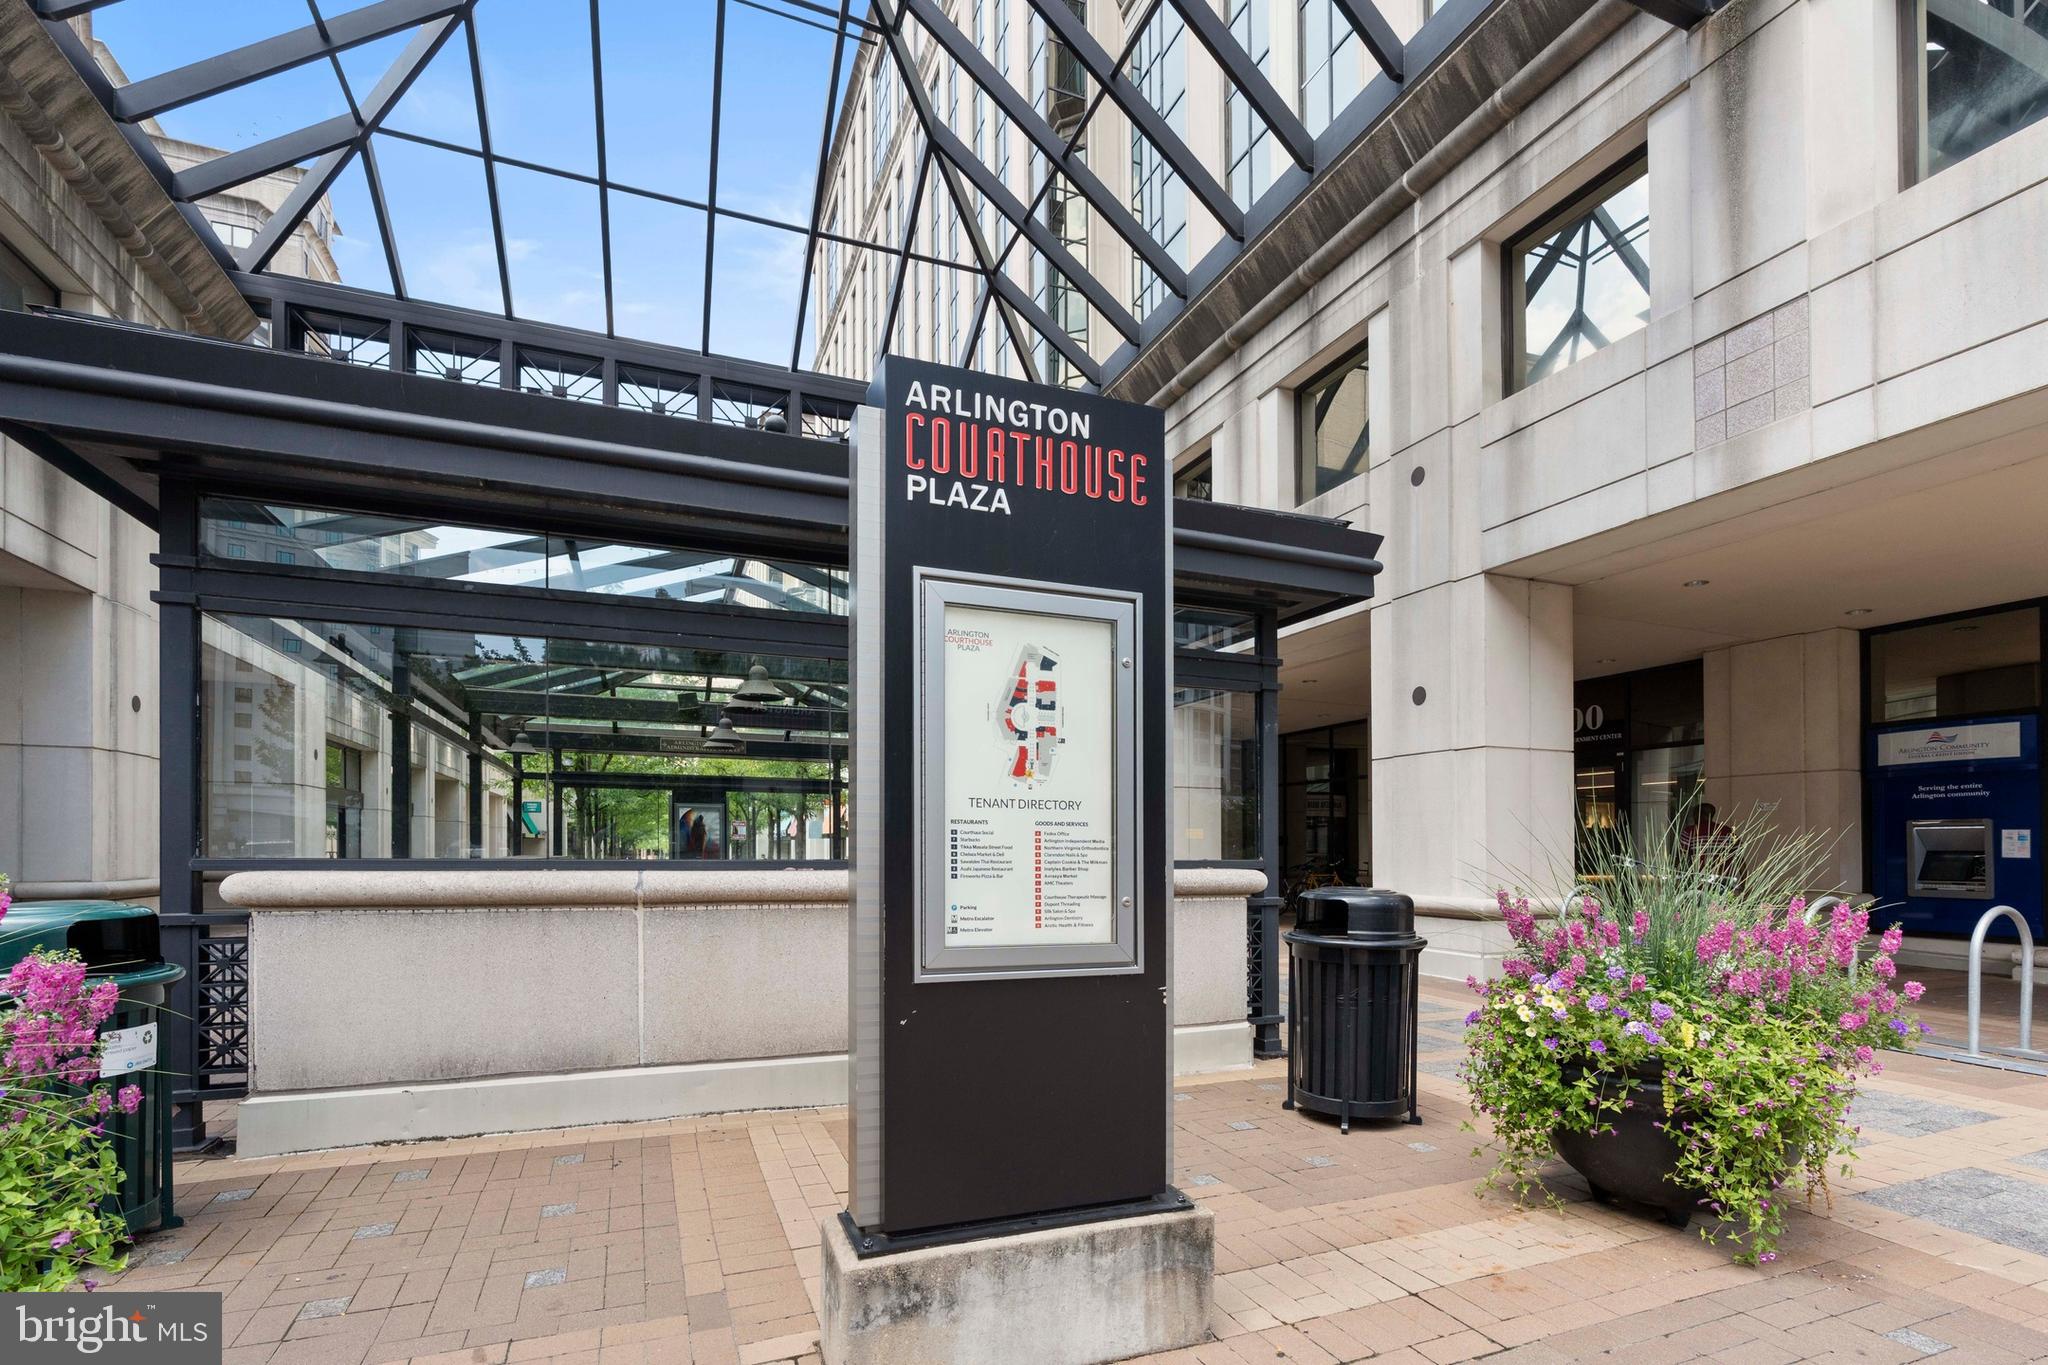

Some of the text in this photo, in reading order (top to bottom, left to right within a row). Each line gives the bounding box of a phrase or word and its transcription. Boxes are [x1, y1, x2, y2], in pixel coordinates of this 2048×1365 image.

[905, 380, 1090, 439] ARLINGTON
[905, 412, 1148, 506] COURTHOUSE
[906, 474, 1012, 515] PLAZA
[947, 628, 990, 638] ARLINGTON
[945, 635, 993, 646] COURTHOUSE
[1918, 784, 1946, 792] Serving
[1960, 782, 1984, 790] entire
[1912, 789, 1991, 800] Arlington community
[968, 797, 1082, 811] TENANT DIRECTORY
